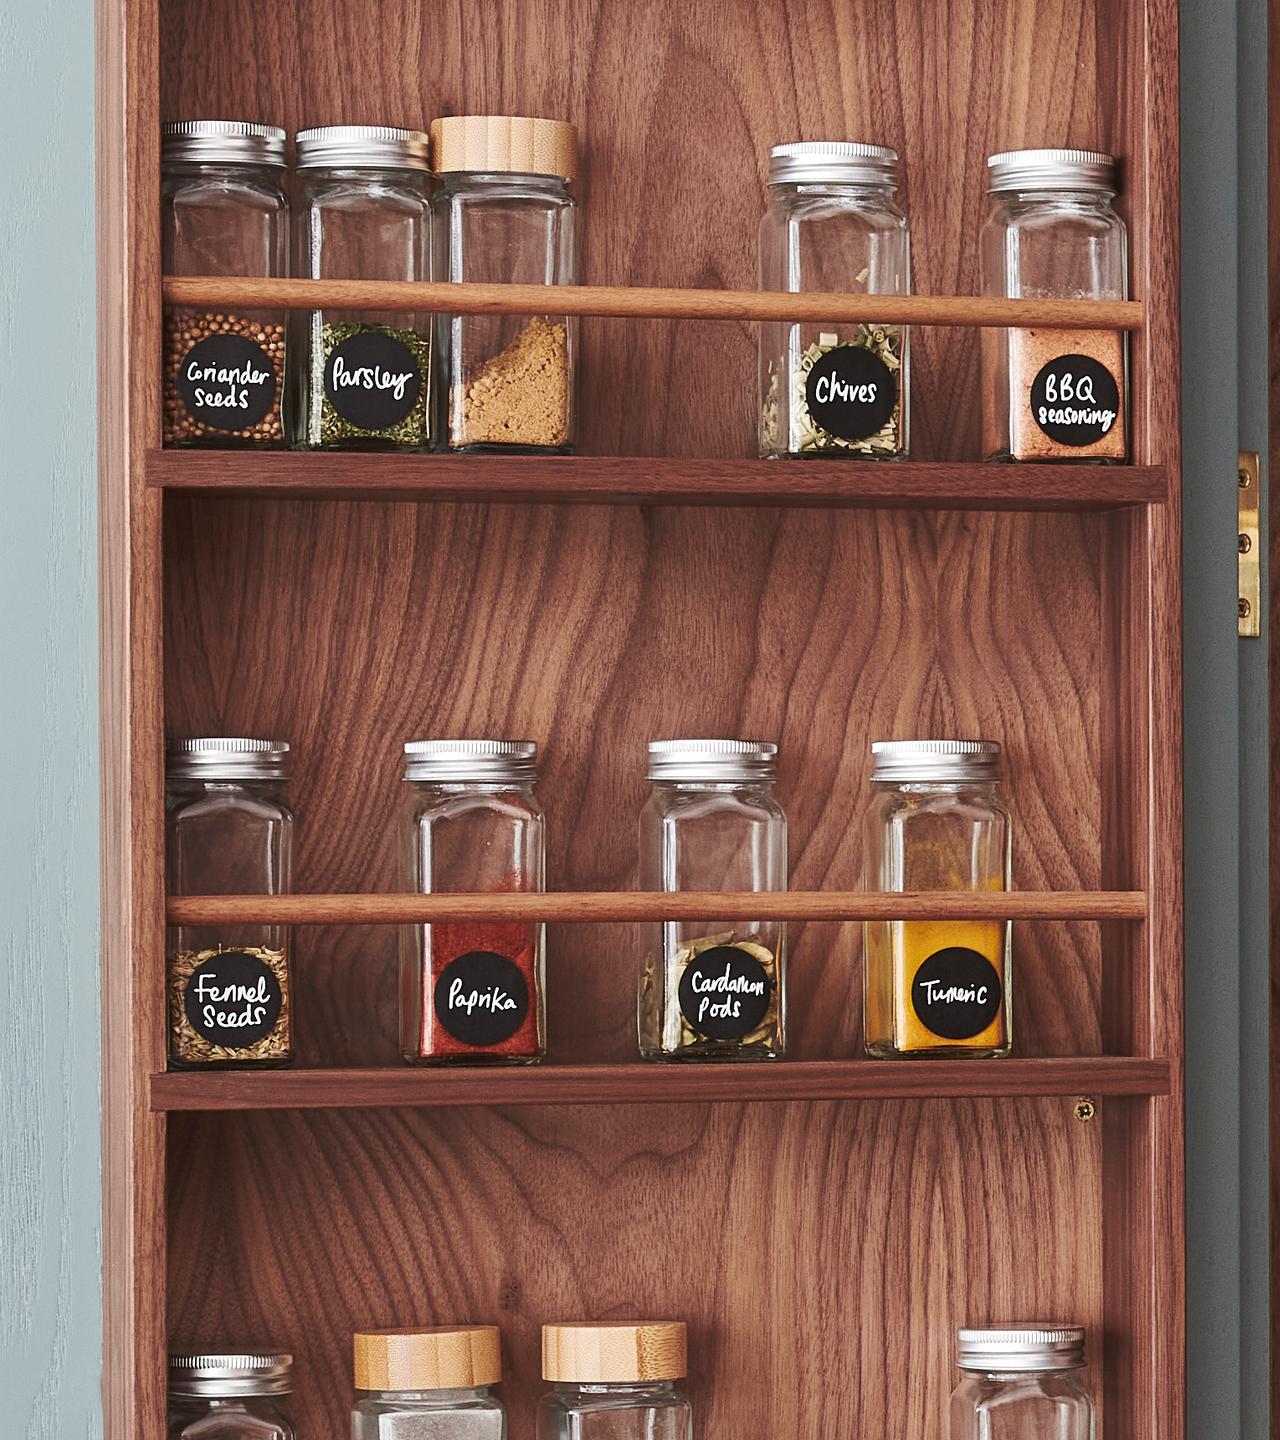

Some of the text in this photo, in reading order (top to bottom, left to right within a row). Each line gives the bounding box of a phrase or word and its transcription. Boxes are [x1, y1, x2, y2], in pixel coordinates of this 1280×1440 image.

[186, 359, 271, 386] Coriander
[332, 356, 414, 401] Parsley
[815, 370, 878, 404] Chives
[1045, 372, 1097, 404] BBQ
[193, 973, 271, 1004] Fennel
[448, 977, 518, 1016] Paprika
[919, 979, 988, 1005] Tumeric
